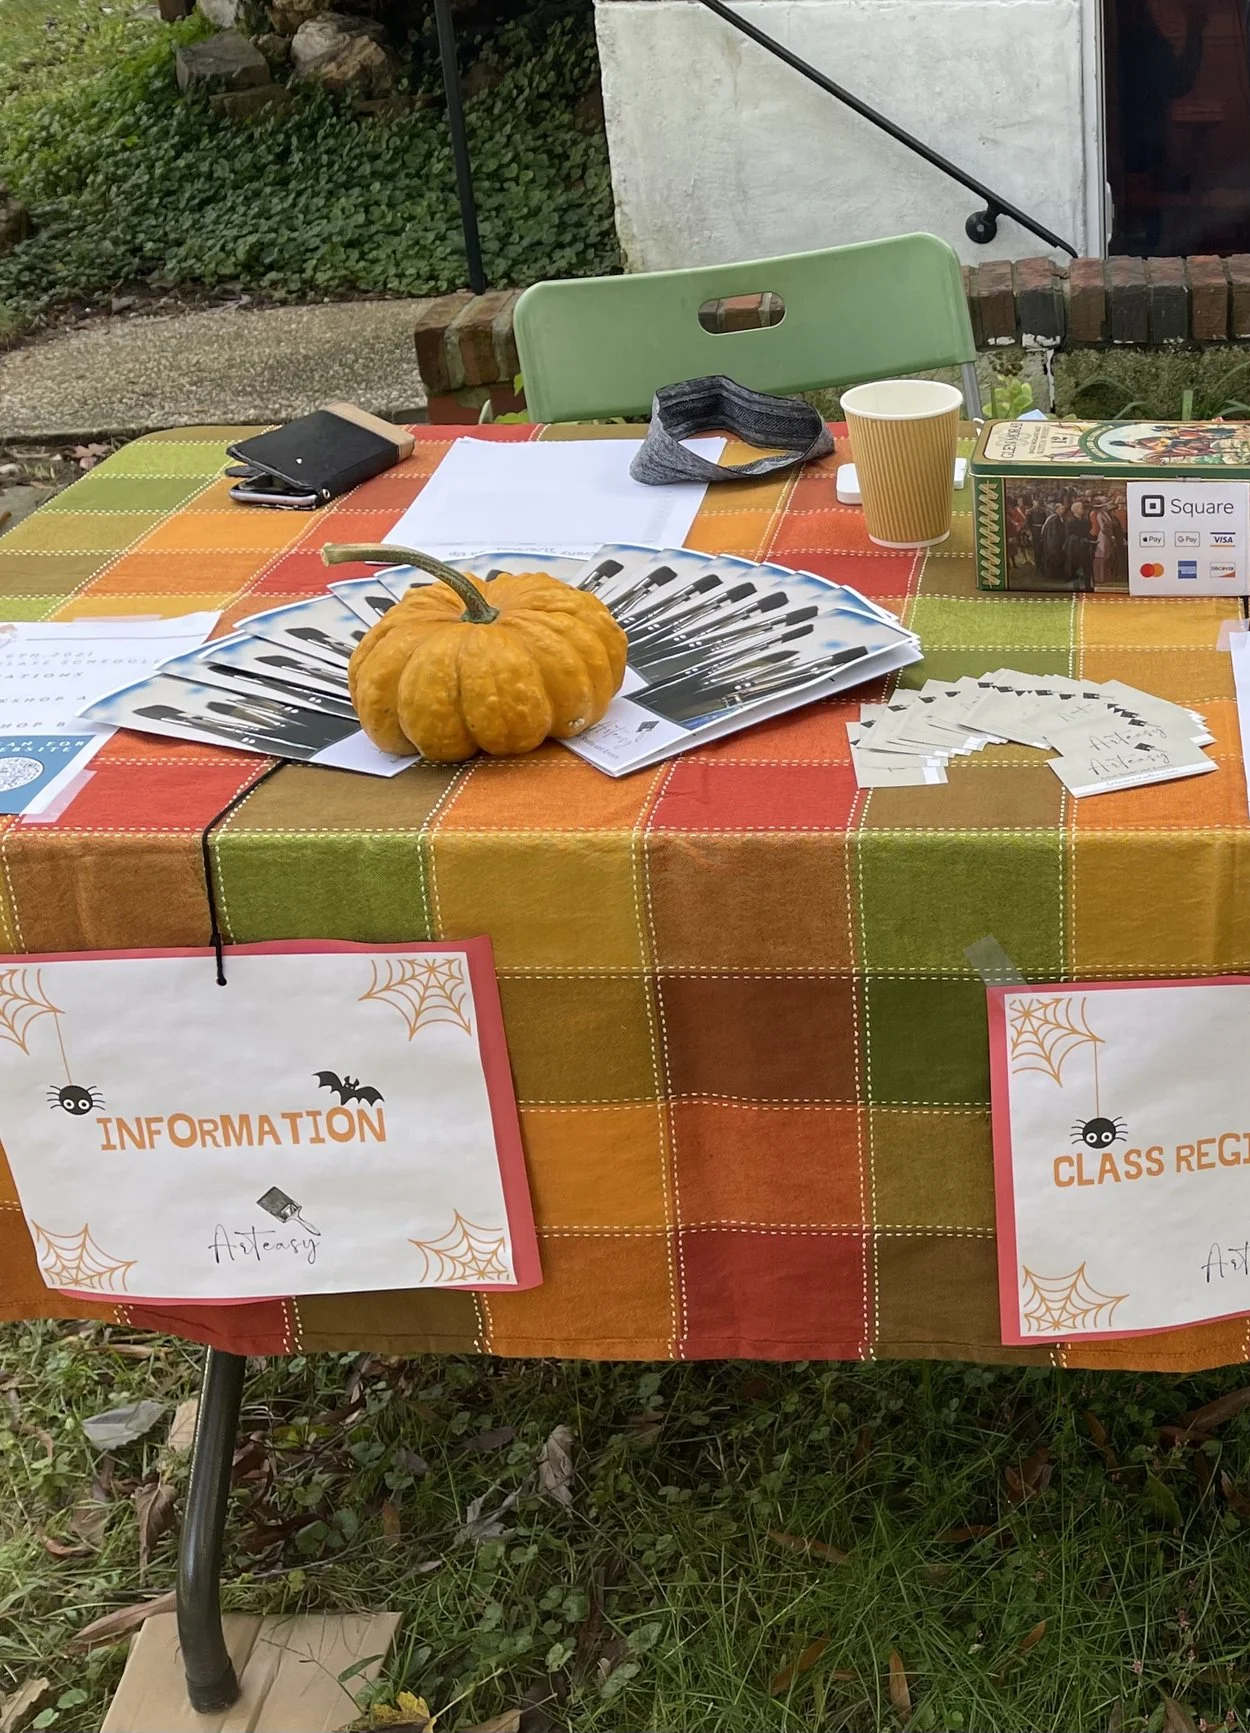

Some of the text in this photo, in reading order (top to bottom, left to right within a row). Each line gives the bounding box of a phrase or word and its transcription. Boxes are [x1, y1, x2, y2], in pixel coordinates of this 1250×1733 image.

[1170, 498, 1234, 518] Square
[96, 1107, 387, 1151] INFORMATION
[1053, 1145, 1165, 1188] CLASS
